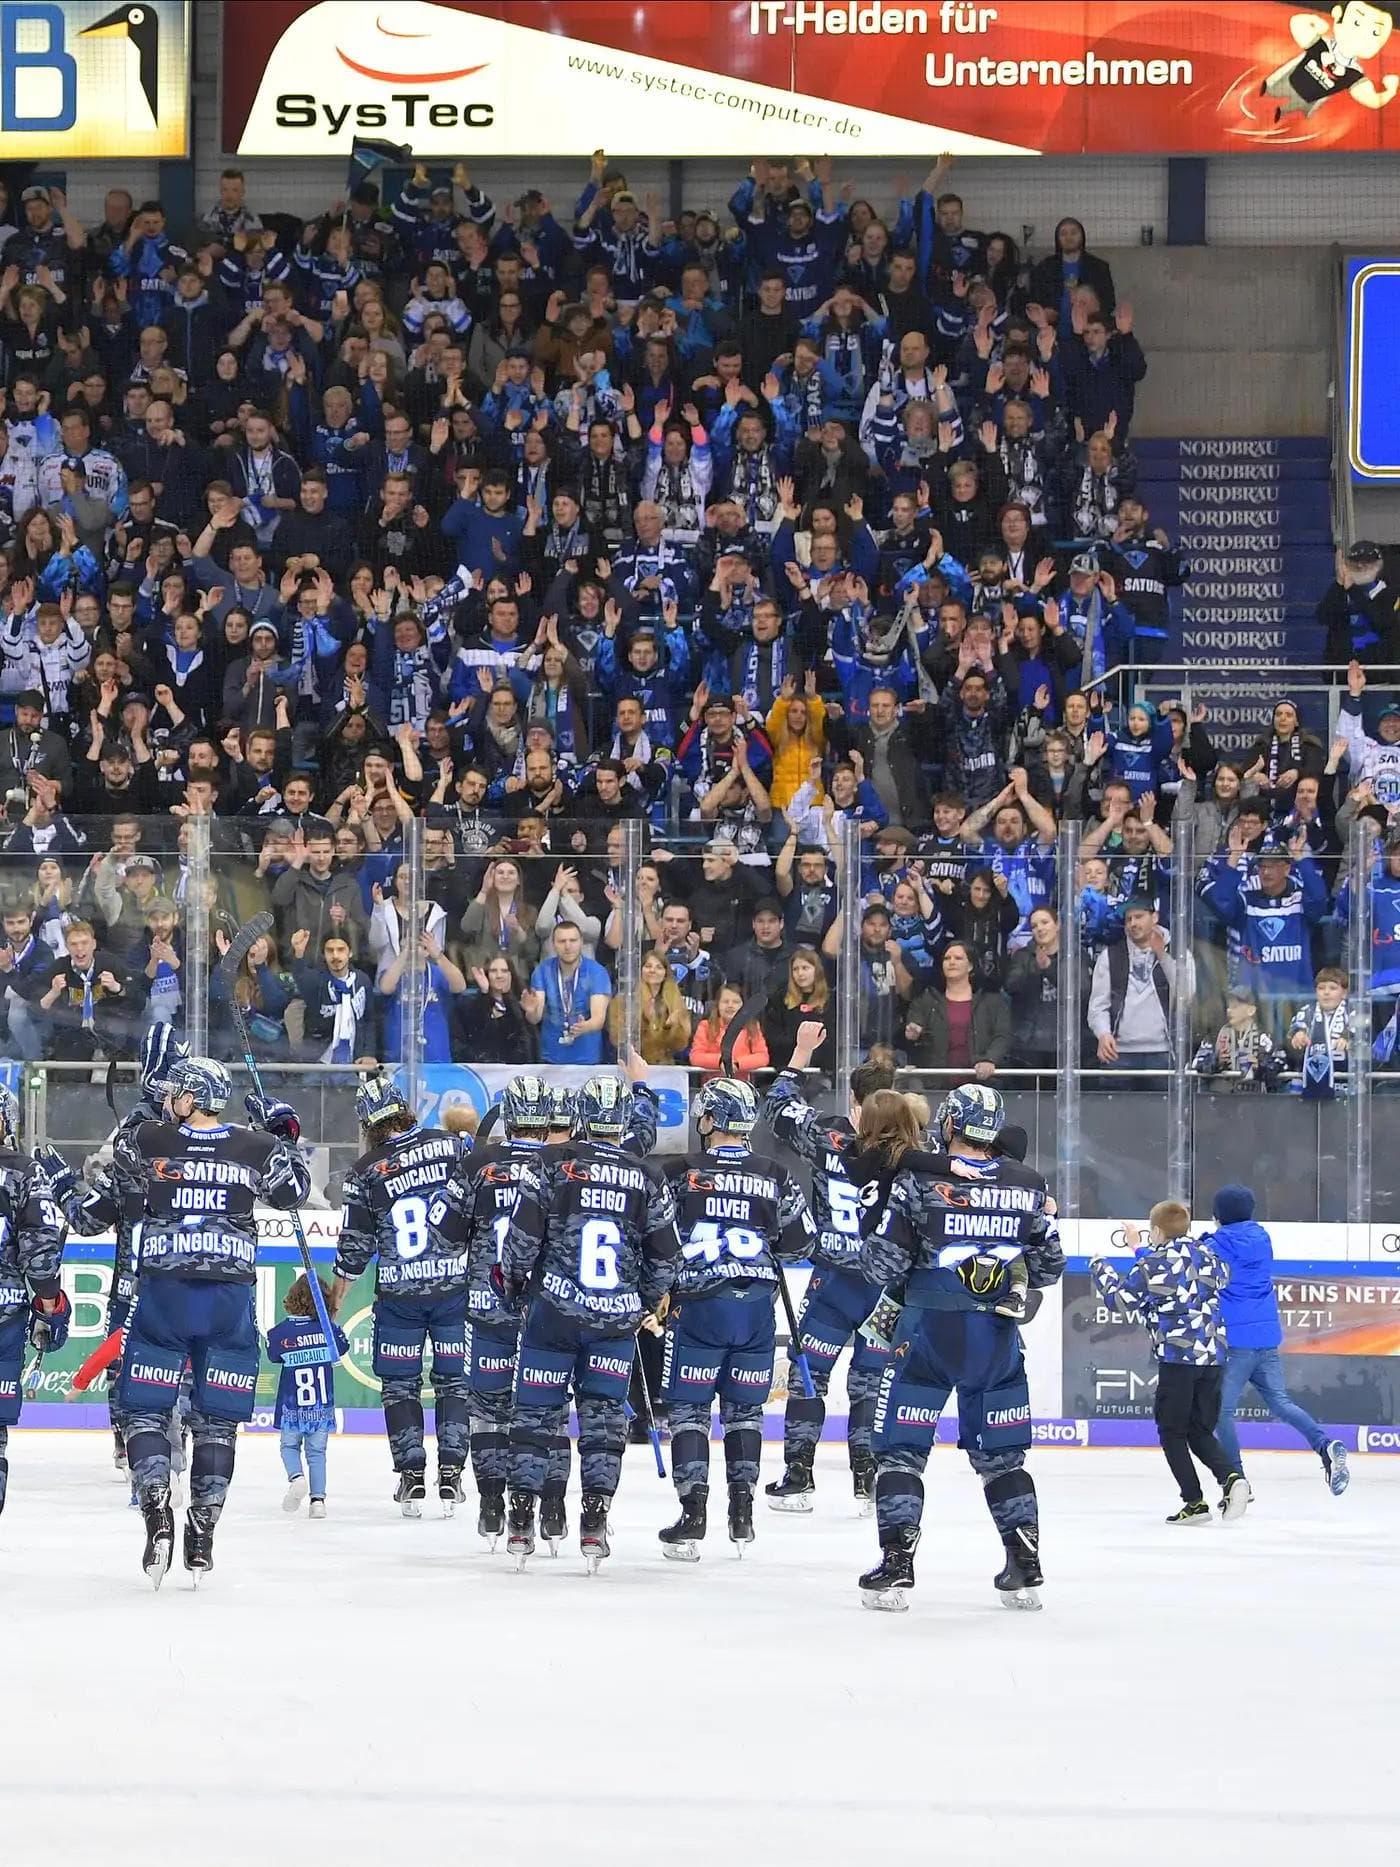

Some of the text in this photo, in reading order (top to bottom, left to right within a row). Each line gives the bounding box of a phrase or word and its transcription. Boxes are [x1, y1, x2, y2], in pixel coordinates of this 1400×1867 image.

[749, 1, 999, 35] IT-Helden für
[925, 51, 1193, 88] Unternehmen
[568, 54, 863, 139] www.systec-computer.de
[275, 94, 494, 136] SysTec
[1179, 439, 1278, 457] NORDBRÄU
[1180, 463, 1280, 481] NORDBRÄU
[1178, 485, 1279, 503] NORDBRÄU
[1178, 509, 1280, 528] NORDBRÄU
[1179, 533, 1281, 552] NORDBRÄU
[1182, 581, 1284, 600] NORDBRÄU
[1182, 606, 1285, 624] NORDBRÄU
[1182, 630, 1286, 649] NORDBRÄU
[1261, 944, 1302, 964] SATUR
[983, 1116, 993, 1126] 23
[398, 1140, 455, 1168] SATURN
[183, 1162, 252, 1187] SATURN
[384, 1162, 448, 1199] FOUCAULT
[714, 1172, 775, 1198] SATURN
[171, 1187, 227, 1211] JOBKE
[580, 1187, 627, 1213] SEIGO
[705, 1197, 750, 1220] OLVER
[969, 1188, 1035, 1212] SATURN
[391, 1196, 429, 1259] 8
[944, 1213, 1020, 1238] EDWARDS
[142, 1232, 256, 1265] ERC INGOLSTADT
[578, 1217, 621, 1290] 6
[378, 1266, 399, 1284] ERC
[542, 1272, 570, 1299] ERC
[1299, 1285, 1339, 1303] INS
[296, 1333, 329, 1347] SATUR
[380, 1341, 421, 1357] CINQUE
[802, 1333, 842, 1356] CINQUE
[288, 1348, 328, 1365] FOUCAULT
[589, 1354, 631, 1376] CINQUE
[660, 1330, 675, 1389] SATURN
[131, 1363, 180, 1385] CINQUE
[206, 1367, 256, 1390] CINQUE
[523, 1367, 569, 1385] CINQUE
[731, 1367, 771, 1384] CINQUE
[294, 1366, 328, 1407] 81
[874, 1368, 895, 1433] SATURN
[1095, 1404, 1141, 1415] FUTURE
[987, 1404, 1030, 1425] CINQUE
